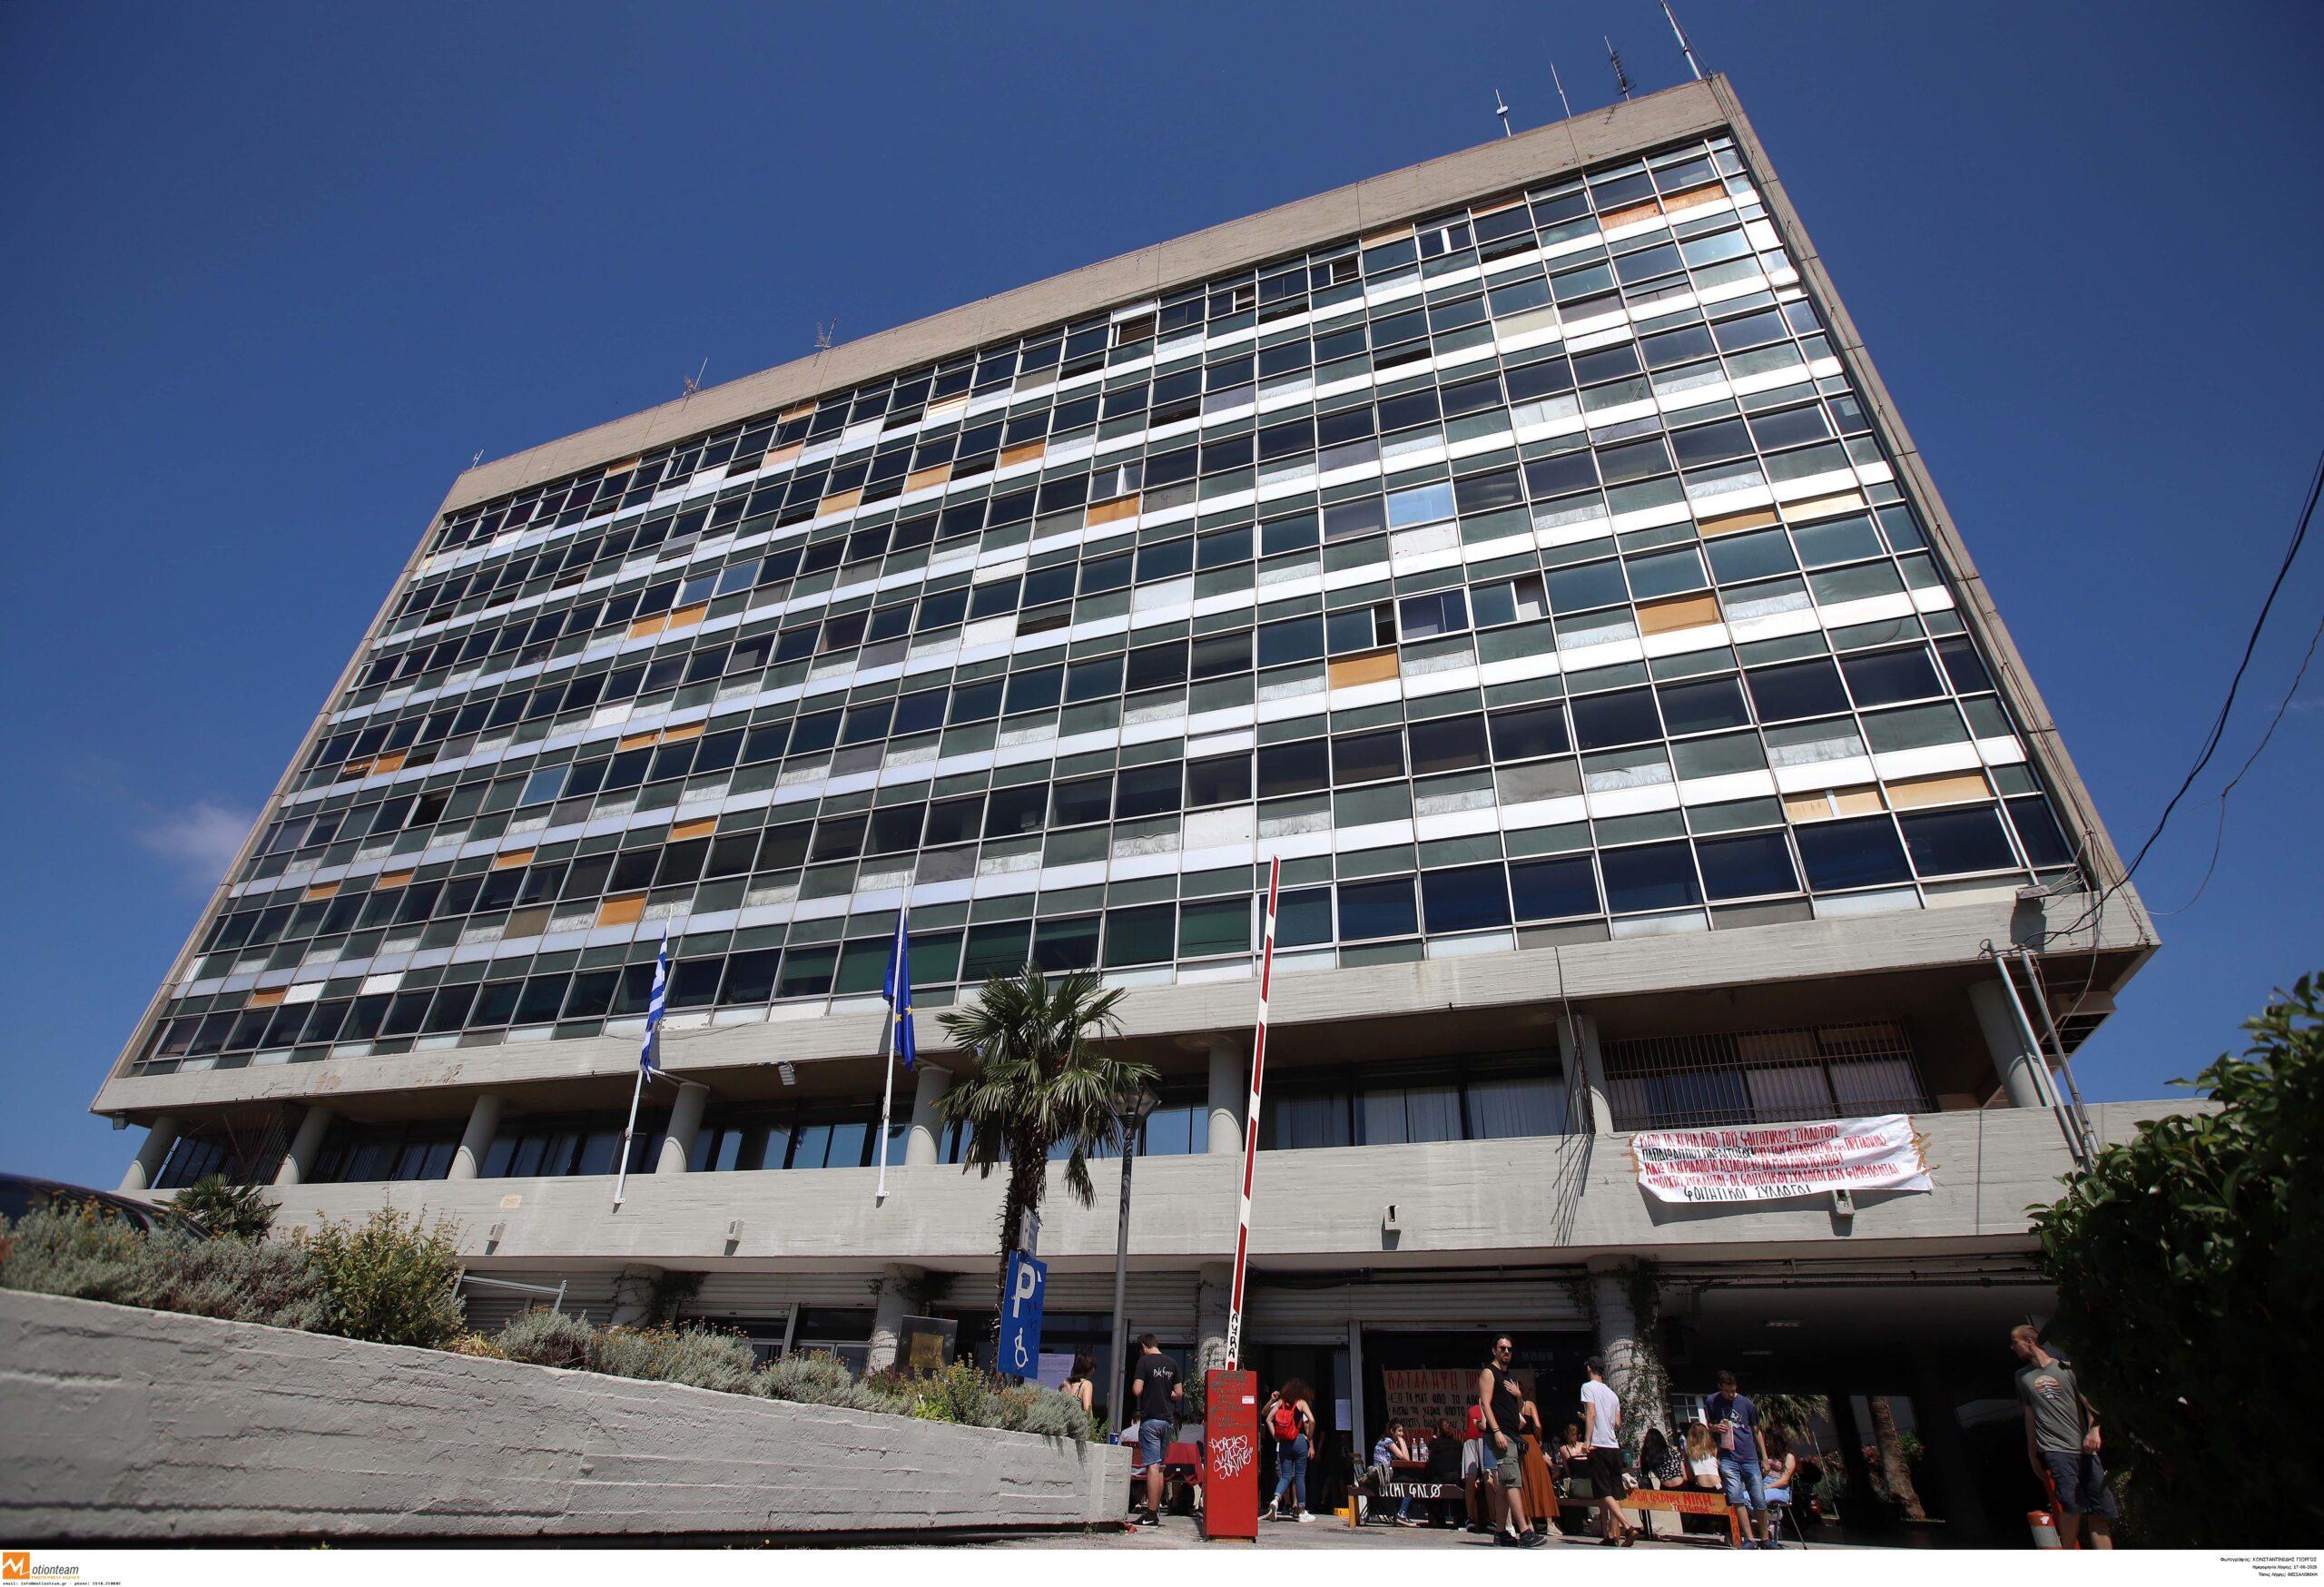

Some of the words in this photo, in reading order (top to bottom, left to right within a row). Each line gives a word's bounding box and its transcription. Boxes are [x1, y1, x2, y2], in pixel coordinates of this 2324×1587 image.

[1640, 1133, 1659, 1147] ΚΑΤΩ
[1663, 1133, 1673, 1146] ΤΑ
[1675, 1133, 1699, 1148] ΧΕΡΙΑ
[1700, 1132, 1718, 1148] ΑΠΟ
[1720, 1131, 1738, 1148] ΤΟΥΣ
[1740, 1129, 1794, 1148] ΦΟΙΤΗΤΙΚΟΥΣ
[1795, 1125, 1839, 1143] ΣΥΛΛΟΓΟΥΣ
[1844, 1133, 1888, 1151] ΠΡΥΤΑΝΕΙΑΣ
[1645, 1162, 1665, 1176] ΚΑΤΩ
[1666, 1162, 1676, 1174] ΤΑ
[1676, 1160, 1696, 1174] ΧΕΡΙΑ
[1709, 1159, 1718, 1172] ΤΟ
[1730, 1174, 1739, 1187] ΟΙ
[1740, 1170, 1788, 1187] ΦΟΙΤΗΤΙΚΟΙ
[1827, 1168, 1845, 1181] ΔΕΝ
[1684, 1186, 1748, 1201] ΦΟΙΤΗΤΙΚΟΙ
[1755, 1184, 1812, 1198] ΣΥΛΛΟΓΟΙ
[1013, 1263, 1036, 1318] P
[1388, 1370, 1458, 1390] ΚΑΤΑΛΗΨΗ
